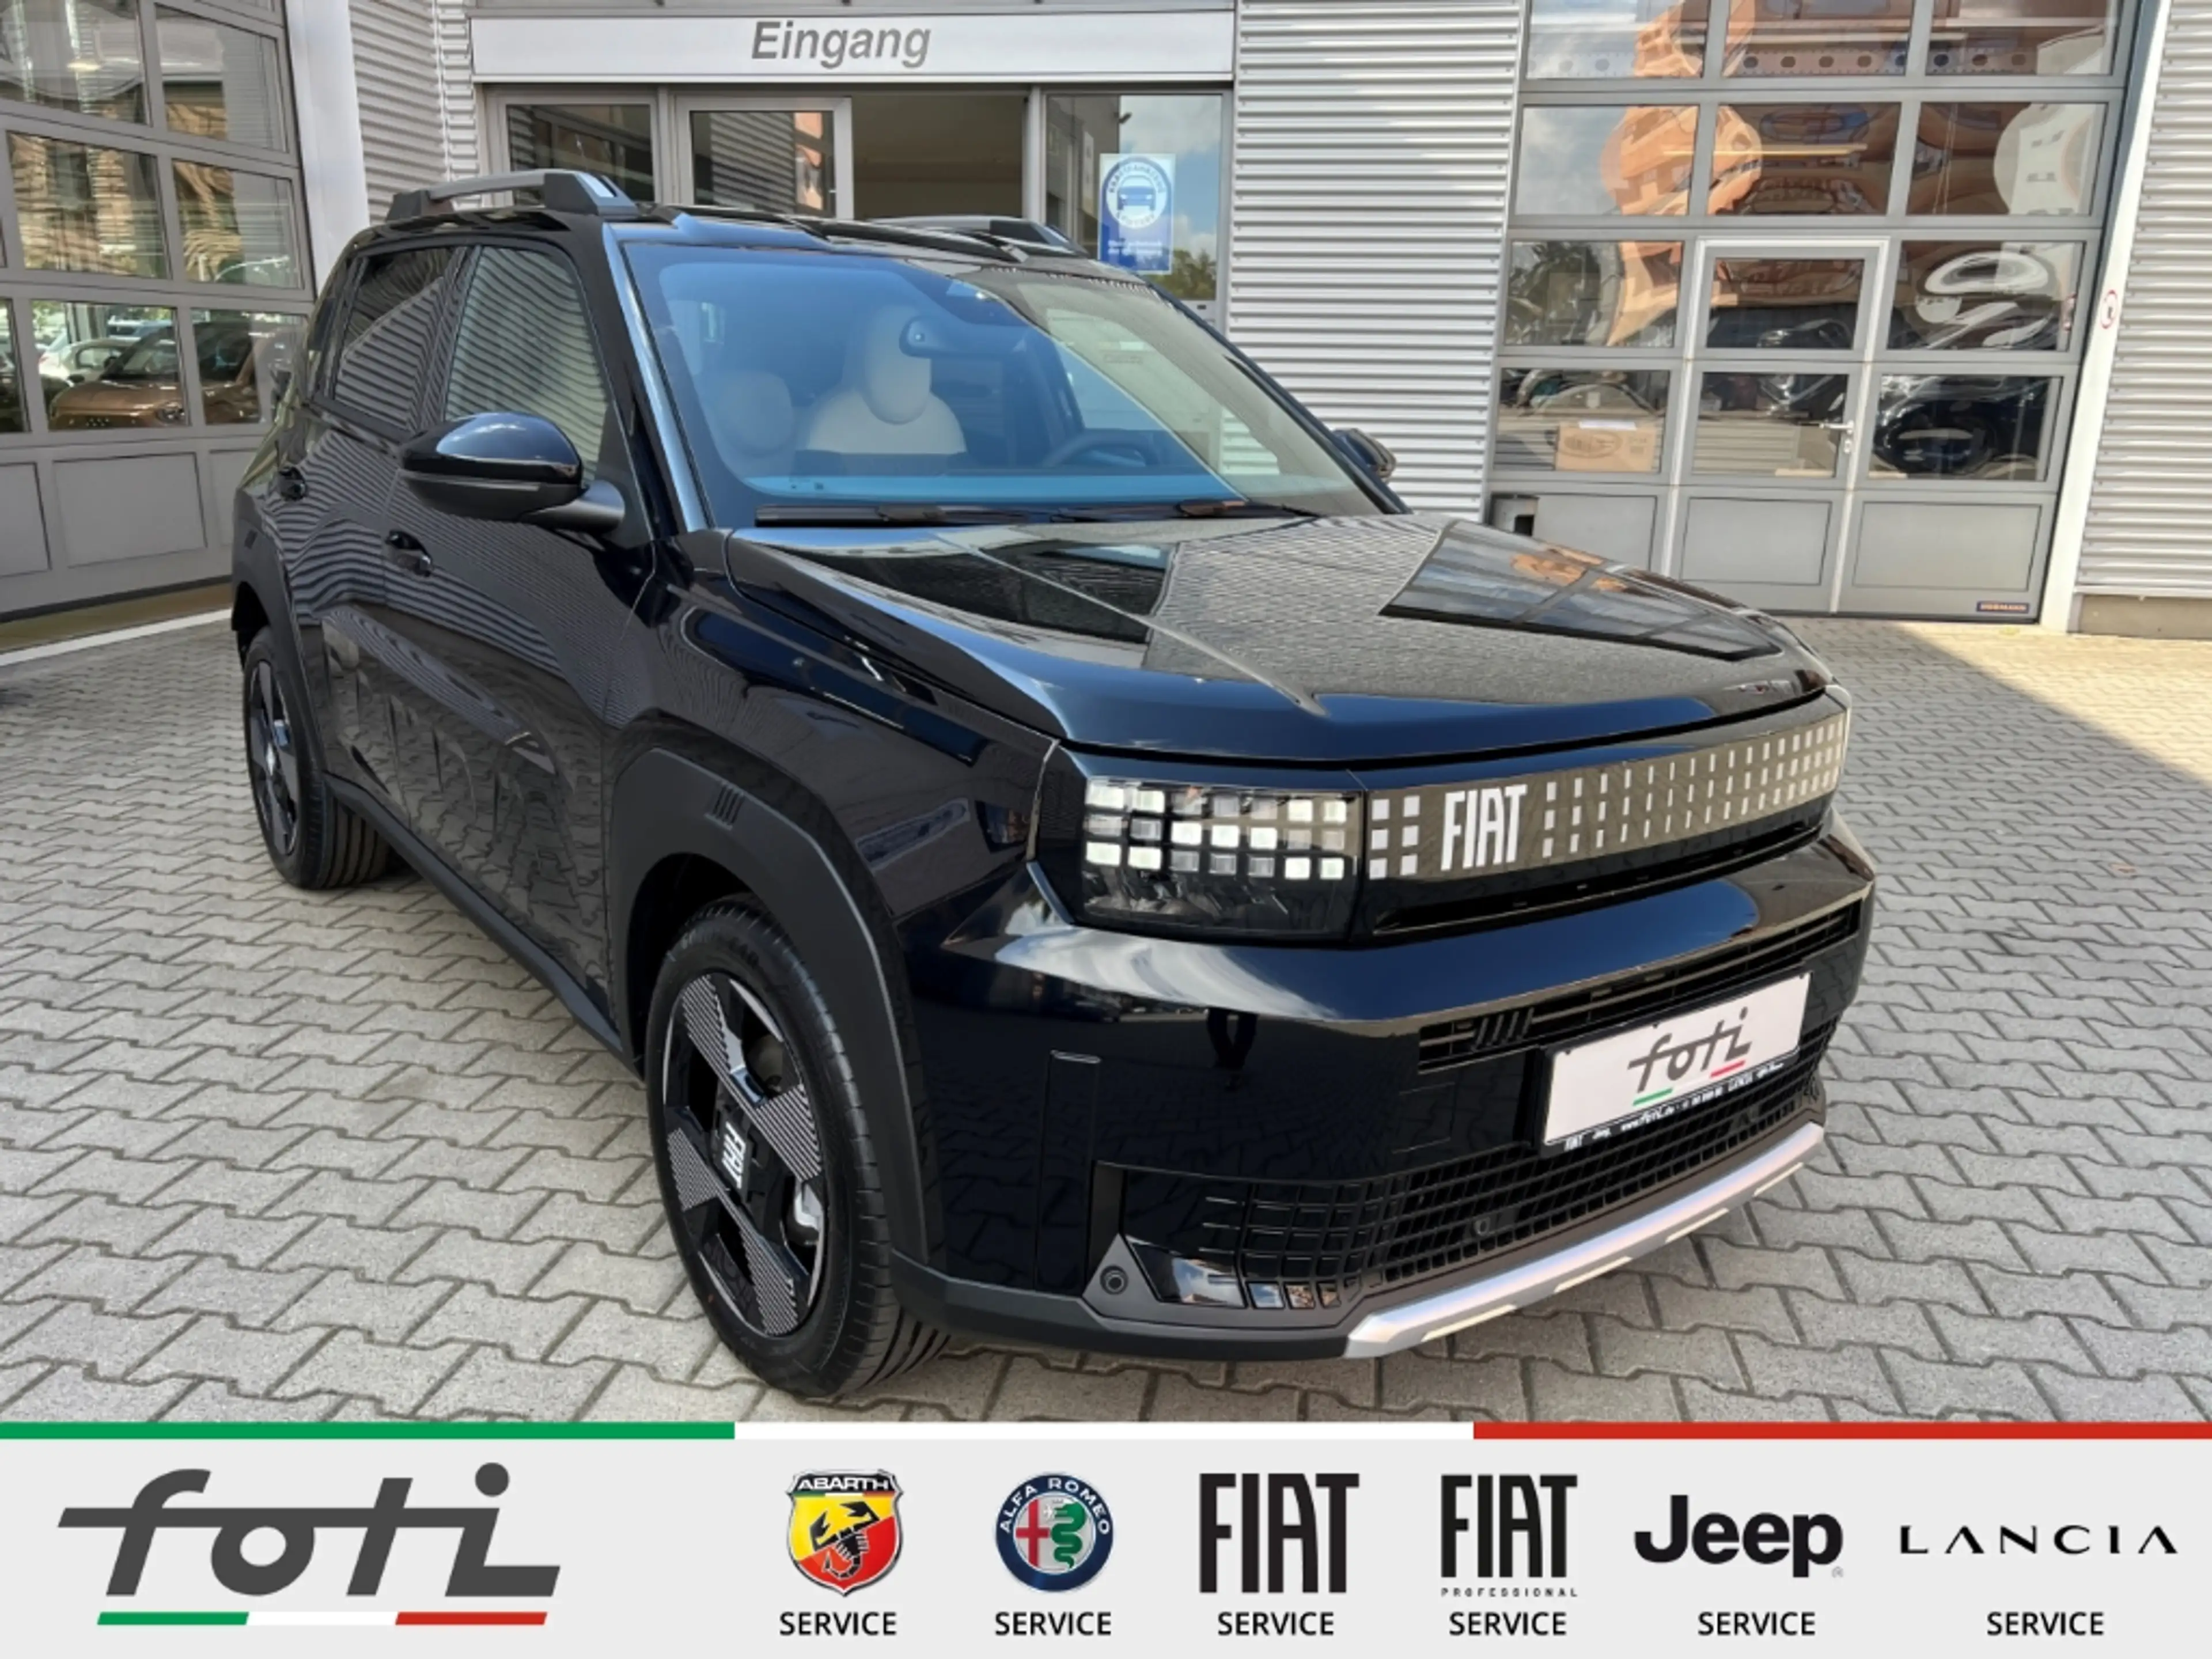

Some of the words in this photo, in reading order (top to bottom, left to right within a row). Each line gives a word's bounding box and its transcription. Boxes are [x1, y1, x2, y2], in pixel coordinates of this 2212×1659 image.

[751, 20, 931, 69] Eingang
[1441, 784, 1528, 871] FIAT
[1627, 1006, 1752, 1093] foti
